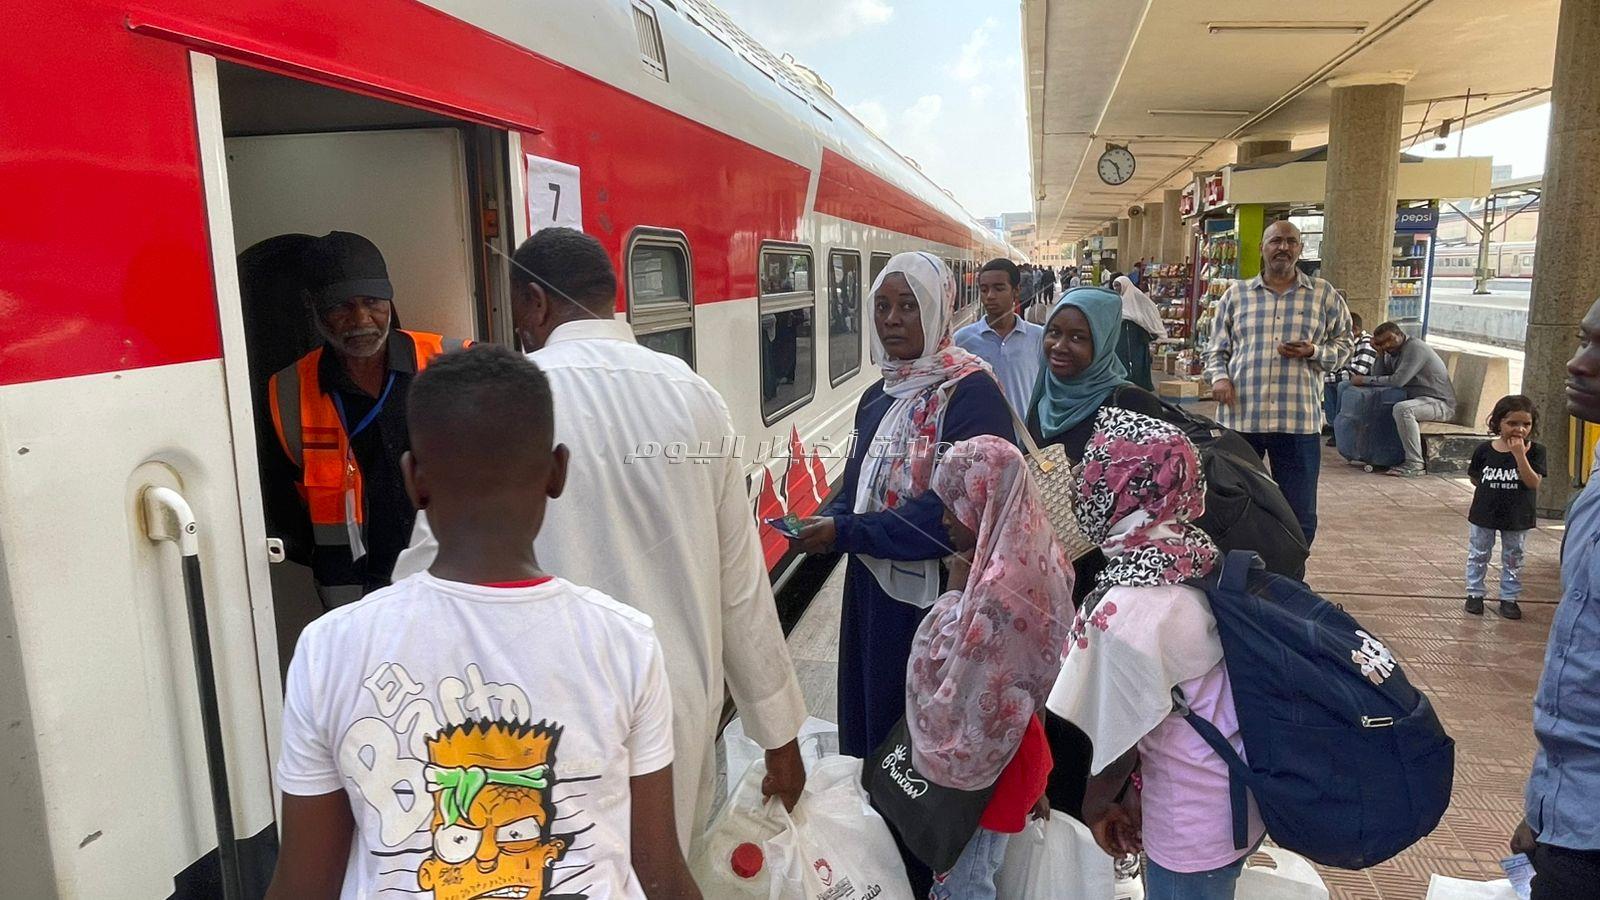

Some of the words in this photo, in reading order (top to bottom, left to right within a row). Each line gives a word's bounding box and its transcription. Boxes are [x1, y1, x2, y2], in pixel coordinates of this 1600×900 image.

[548, 182, 561, 222] 7
[1401, 213, 1432, 223] pepsi
[881, 752, 929, 799] Princess
